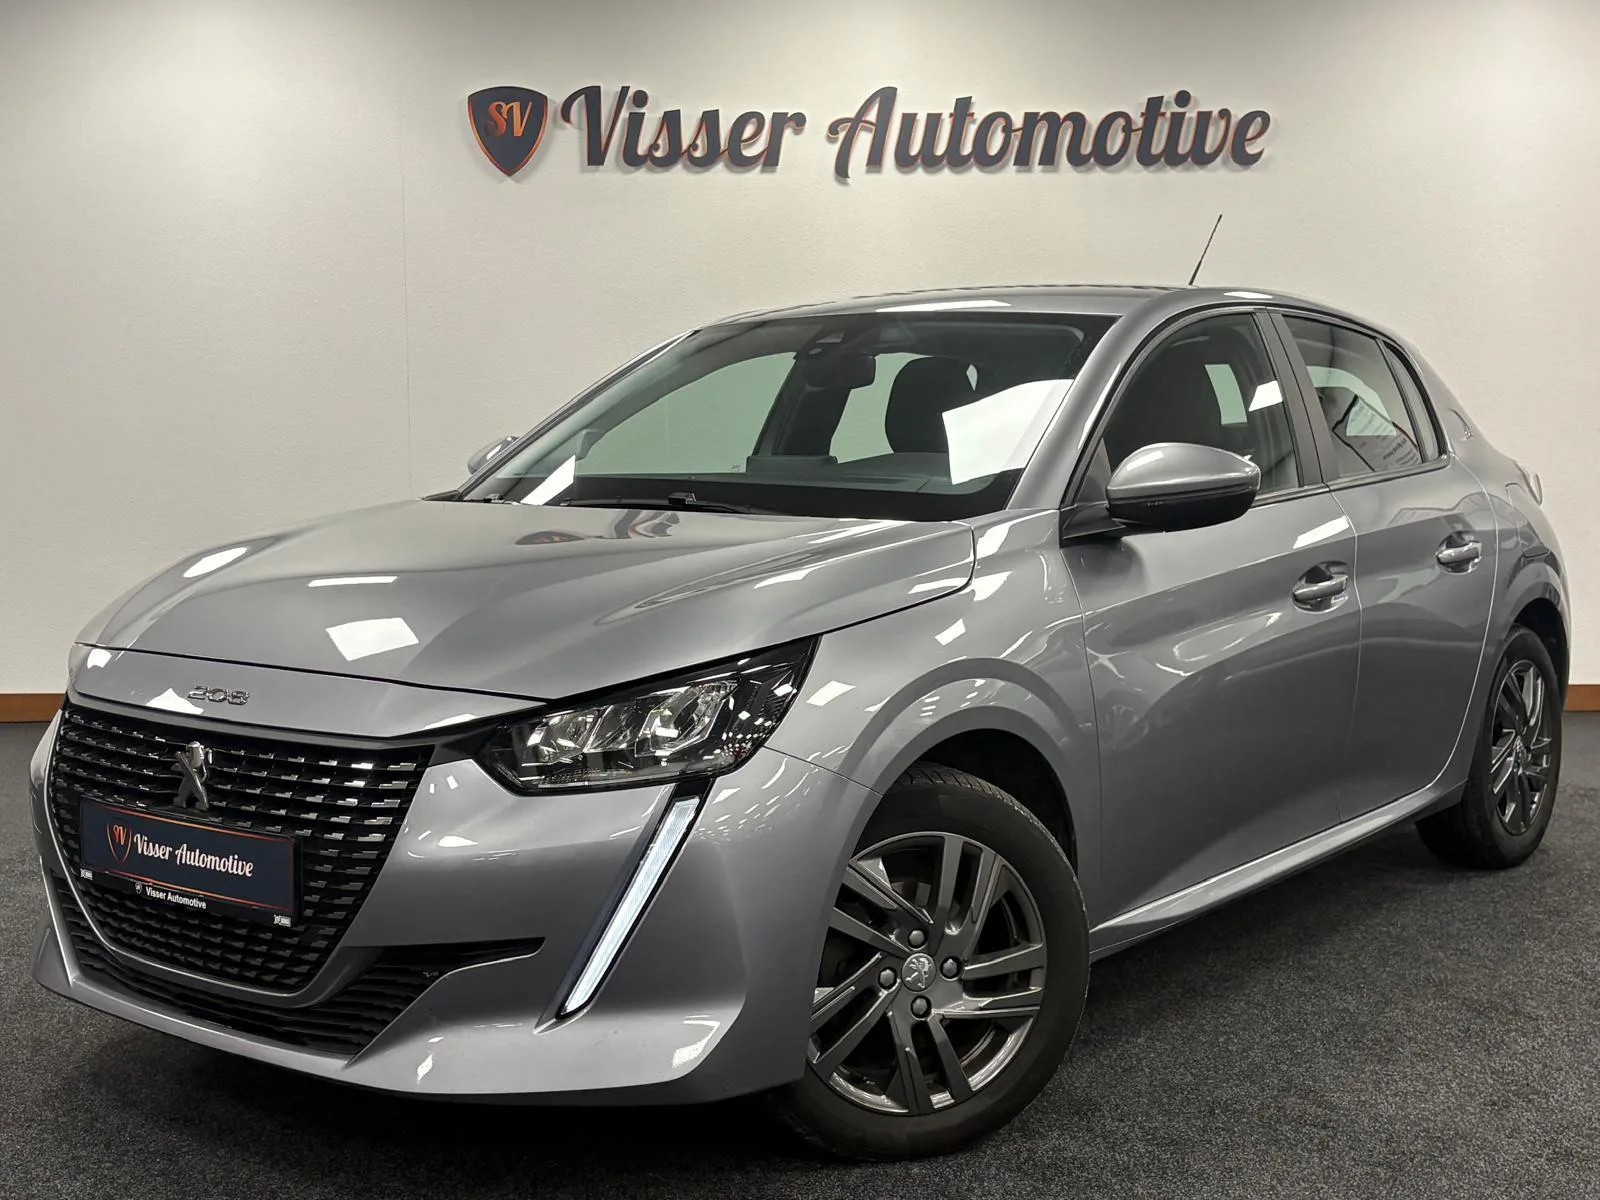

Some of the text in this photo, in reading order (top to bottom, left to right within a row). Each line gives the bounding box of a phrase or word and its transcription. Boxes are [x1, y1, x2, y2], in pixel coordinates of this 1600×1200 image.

[561, 85, 1272, 185] Visser Automotive
[187, 685, 249, 706] 208
[133, 833, 254, 877] Visser Automotive
[146, 886, 207, 910] Visser Automotive
